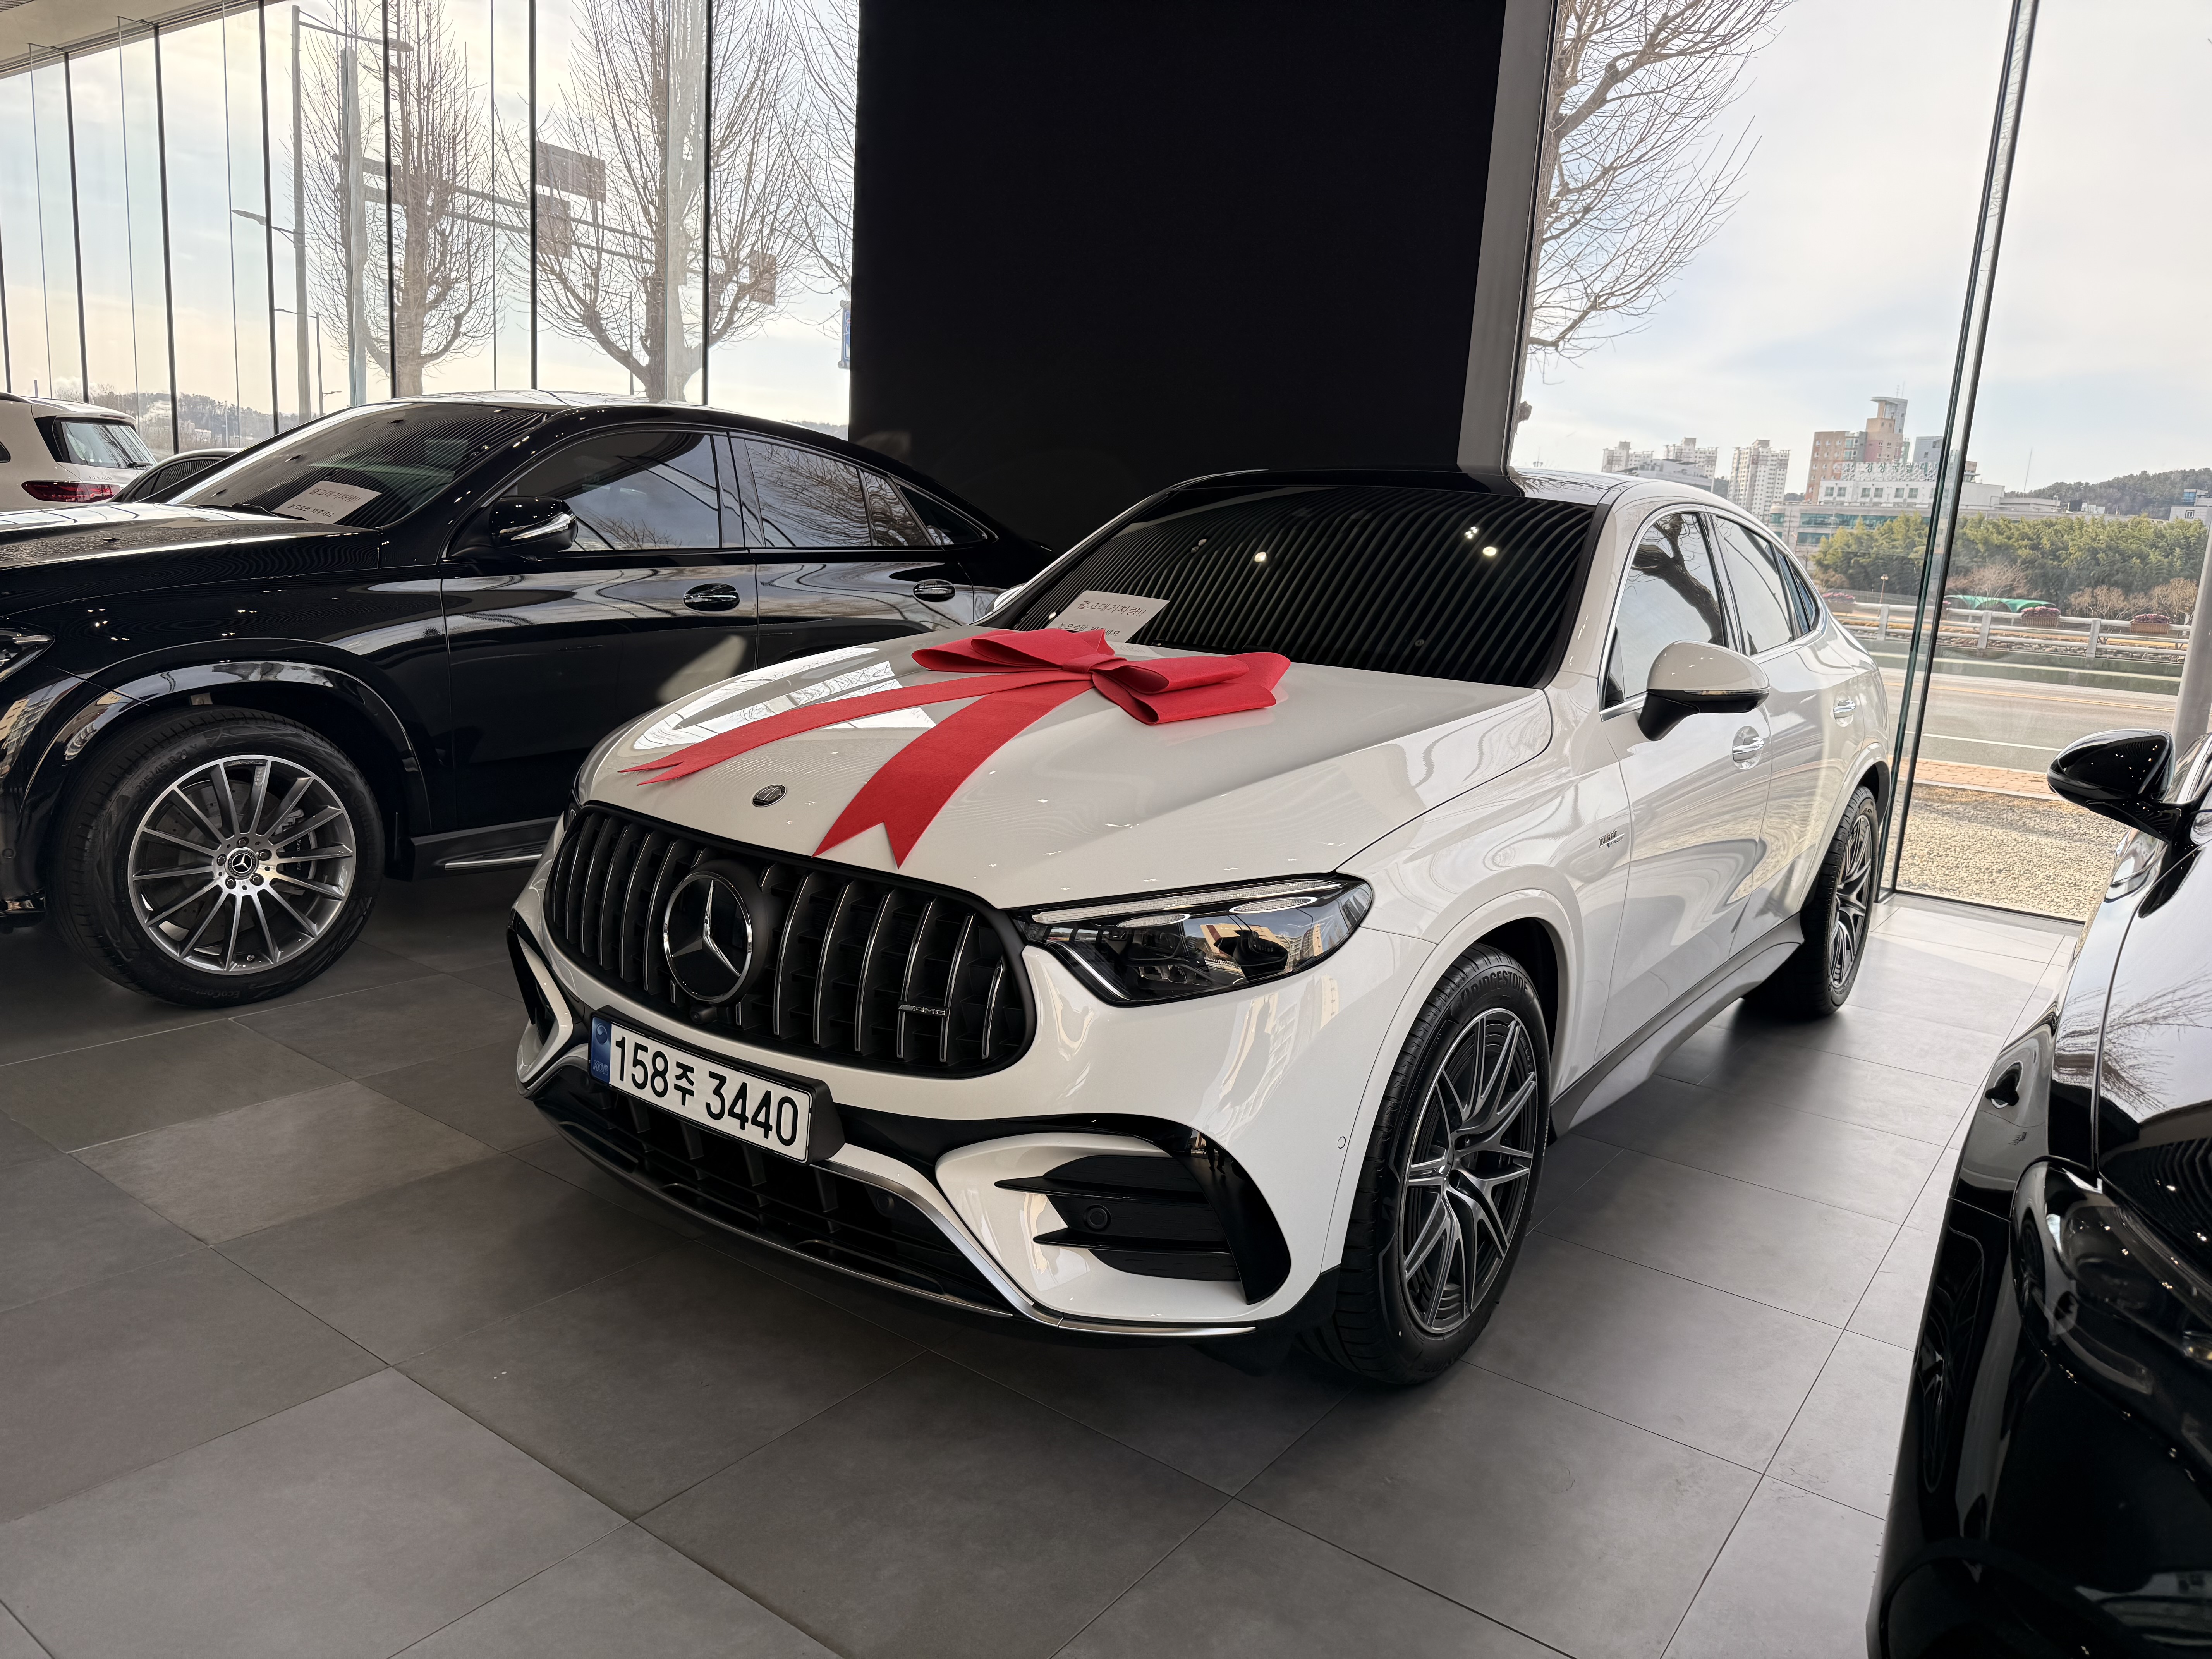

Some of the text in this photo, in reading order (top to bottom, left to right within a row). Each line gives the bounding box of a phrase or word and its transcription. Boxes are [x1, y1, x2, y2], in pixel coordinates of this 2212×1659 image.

[1077, 601, 1147, 617] 출고대기차량!!
[1460, 970, 1528, 1004] BRIDGESTONE
[593, 1059, 608, 1076] KOR
[615, 1036, 799, 1146] 158주 3440
